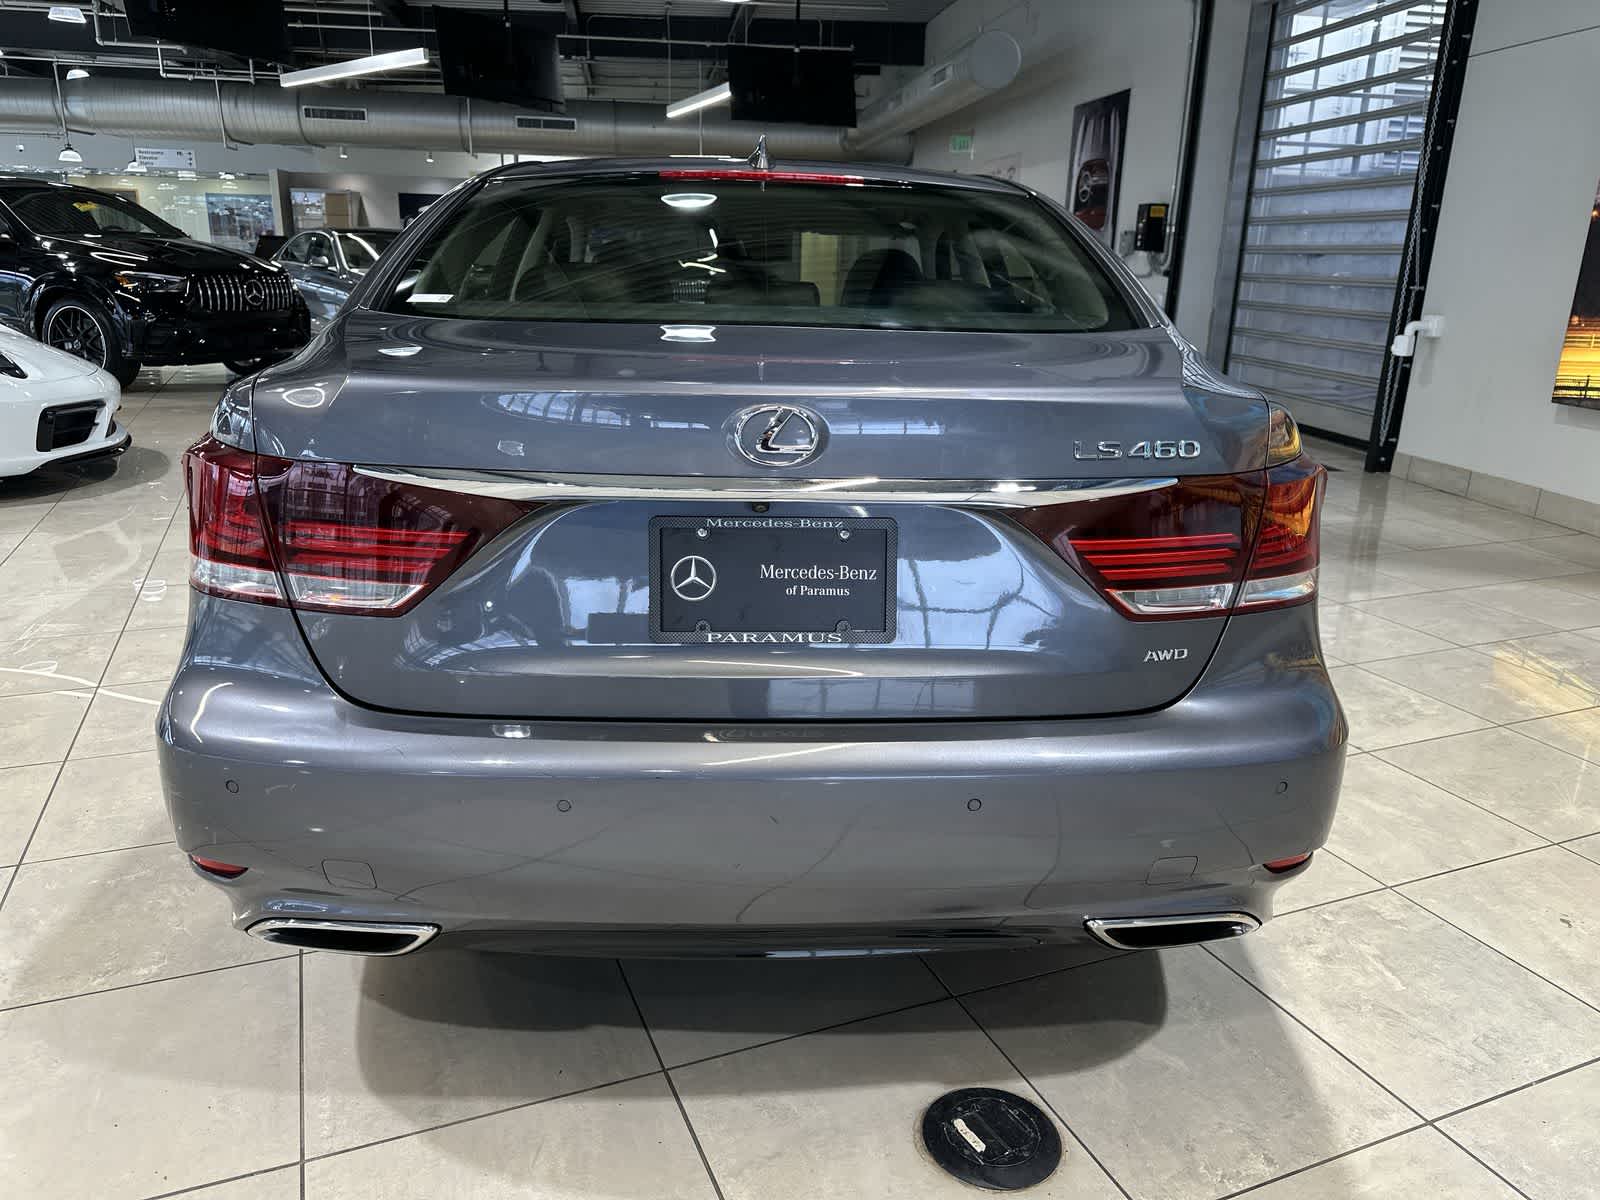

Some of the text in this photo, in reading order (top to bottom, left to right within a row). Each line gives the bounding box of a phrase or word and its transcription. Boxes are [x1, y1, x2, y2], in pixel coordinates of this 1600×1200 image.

[1073, 439, 1201, 460] LS 460
[705, 518, 844, 529] Mercedes-Benz
[759, 564, 877, 581] Mercedes-Benz
[785, 585, 850, 597] of Paramus
[706, 632, 843, 643] PARAMUS
[1143, 648, 1188, 662] AWD
